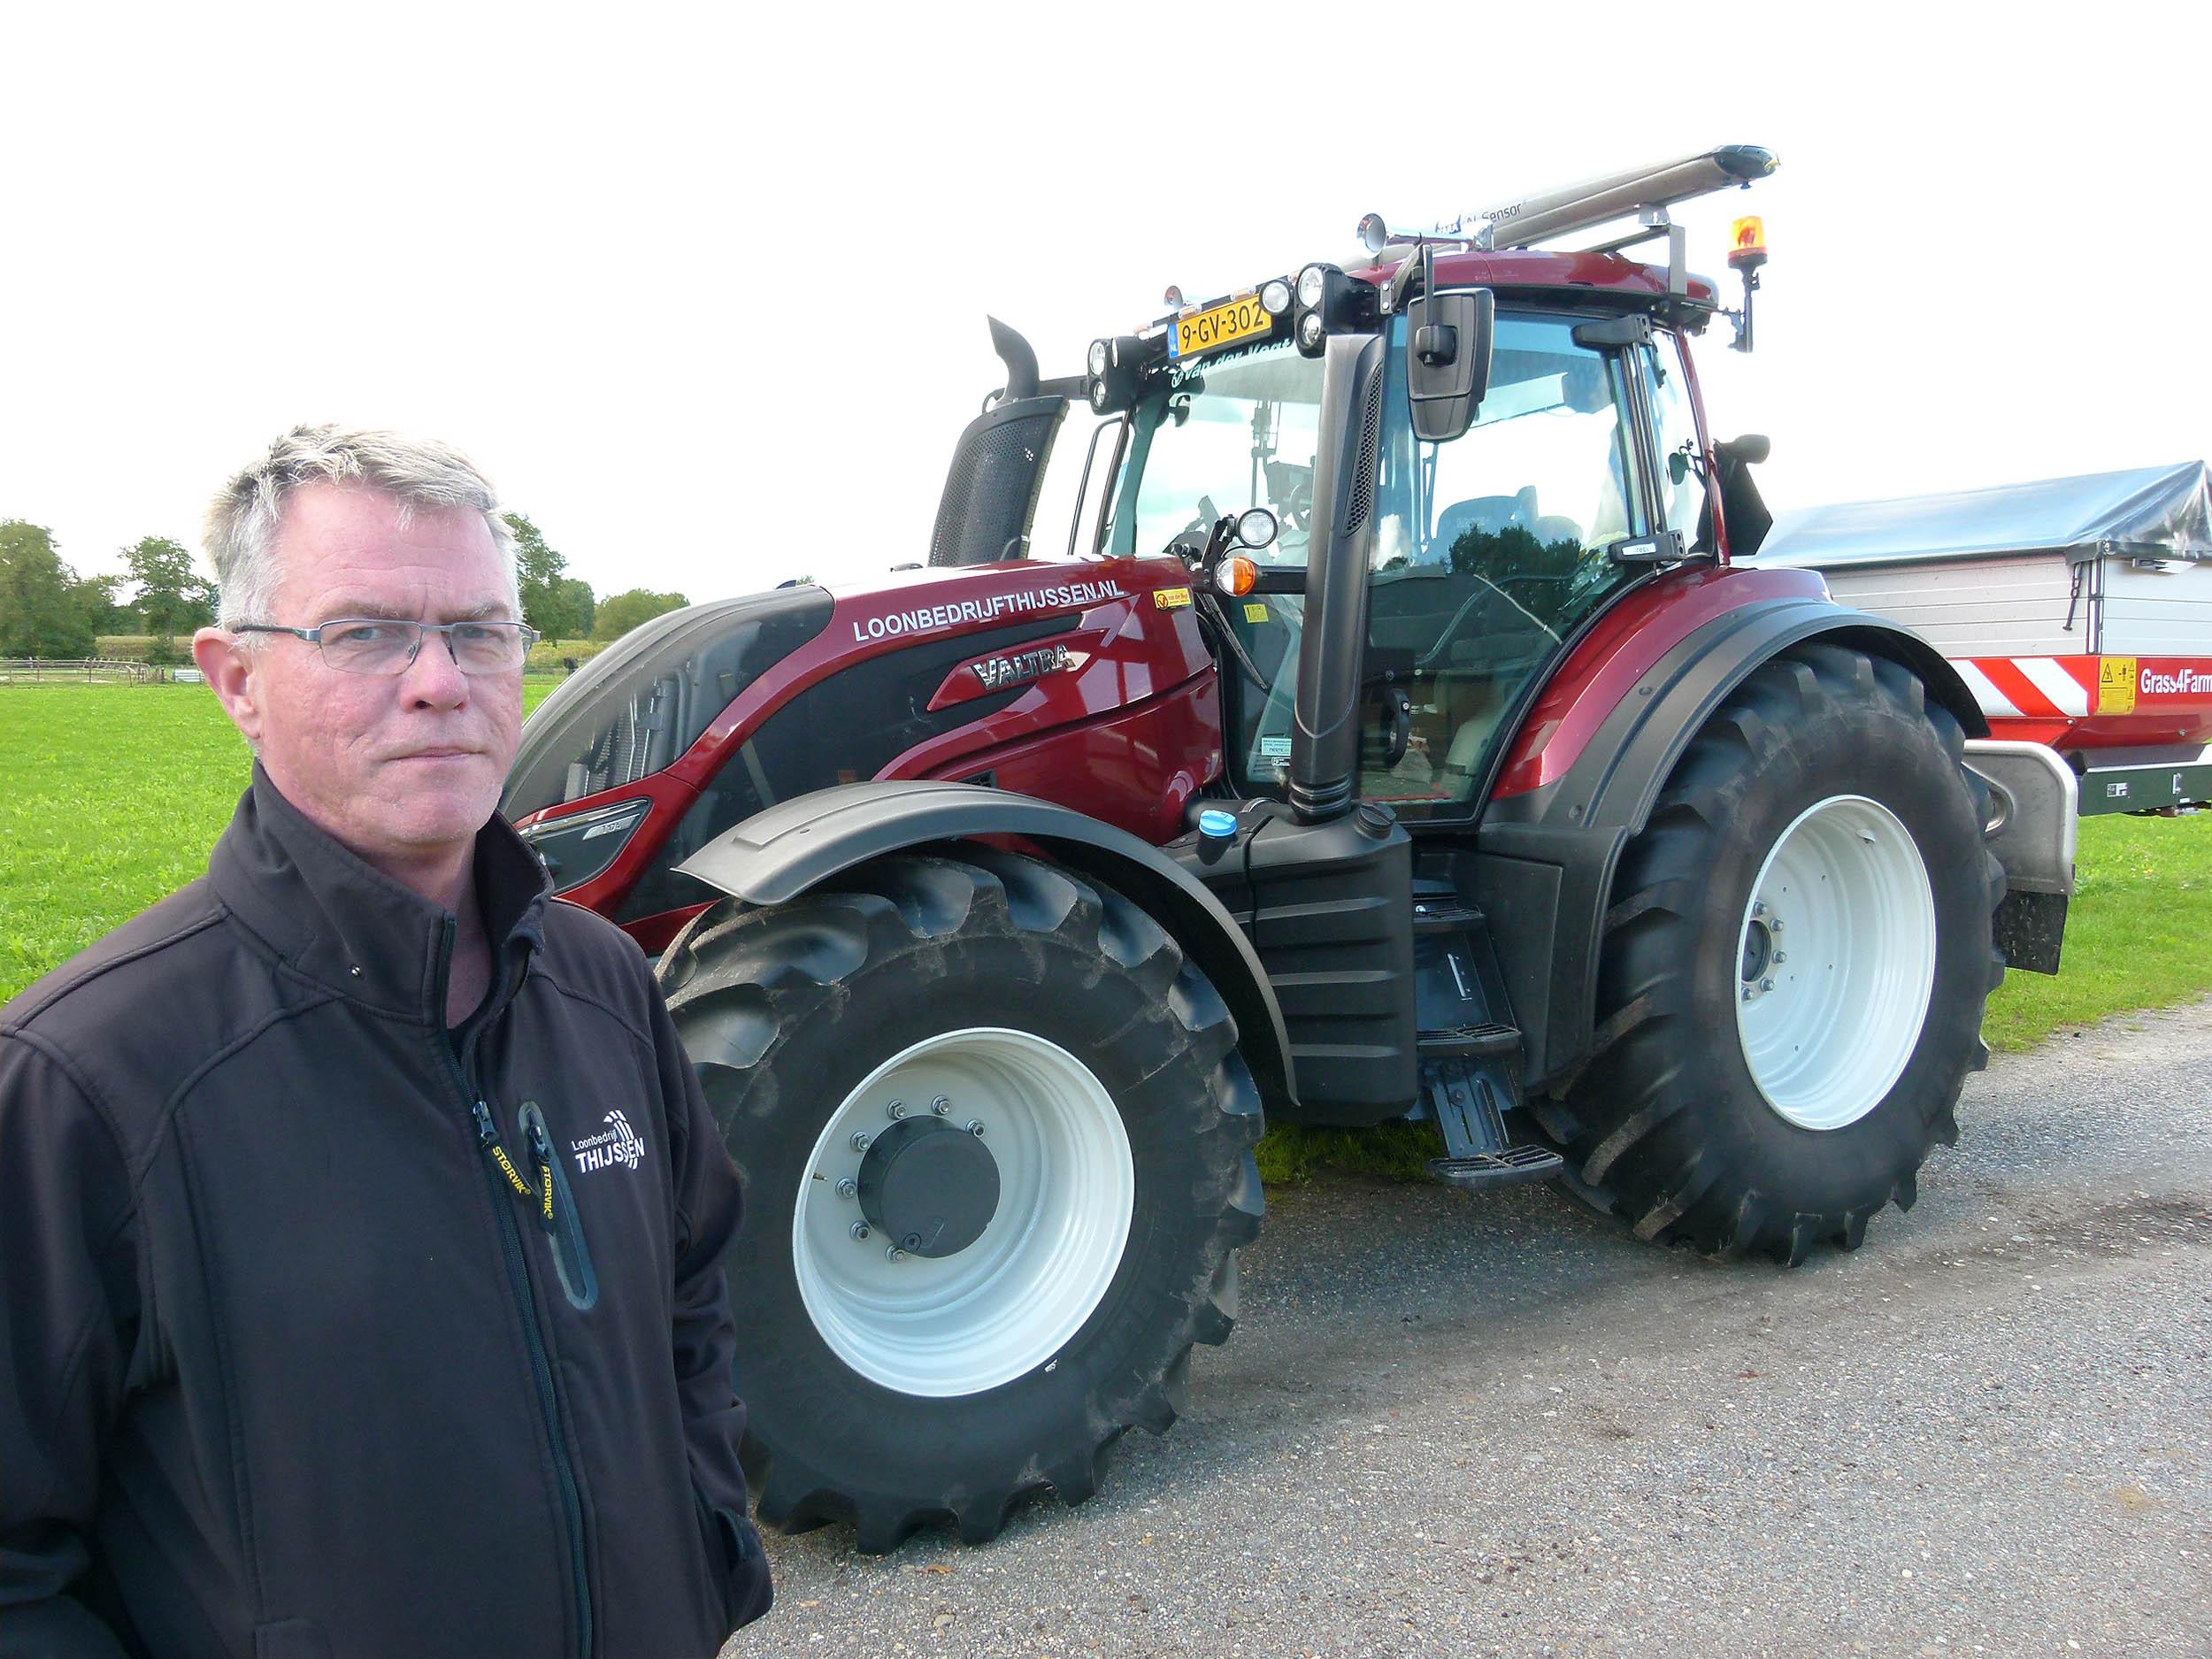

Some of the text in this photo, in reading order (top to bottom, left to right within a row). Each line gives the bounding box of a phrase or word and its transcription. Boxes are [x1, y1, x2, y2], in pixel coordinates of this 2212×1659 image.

[1182, 302, 1263, 349] 9-GV-302
[853, 580, 1125, 642] LOONBEDRIJFTHIJSSEN.NL
[972, 644, 1076, 689] VALTRA
[575, 1137, 645, 1173] THIJSSEN
